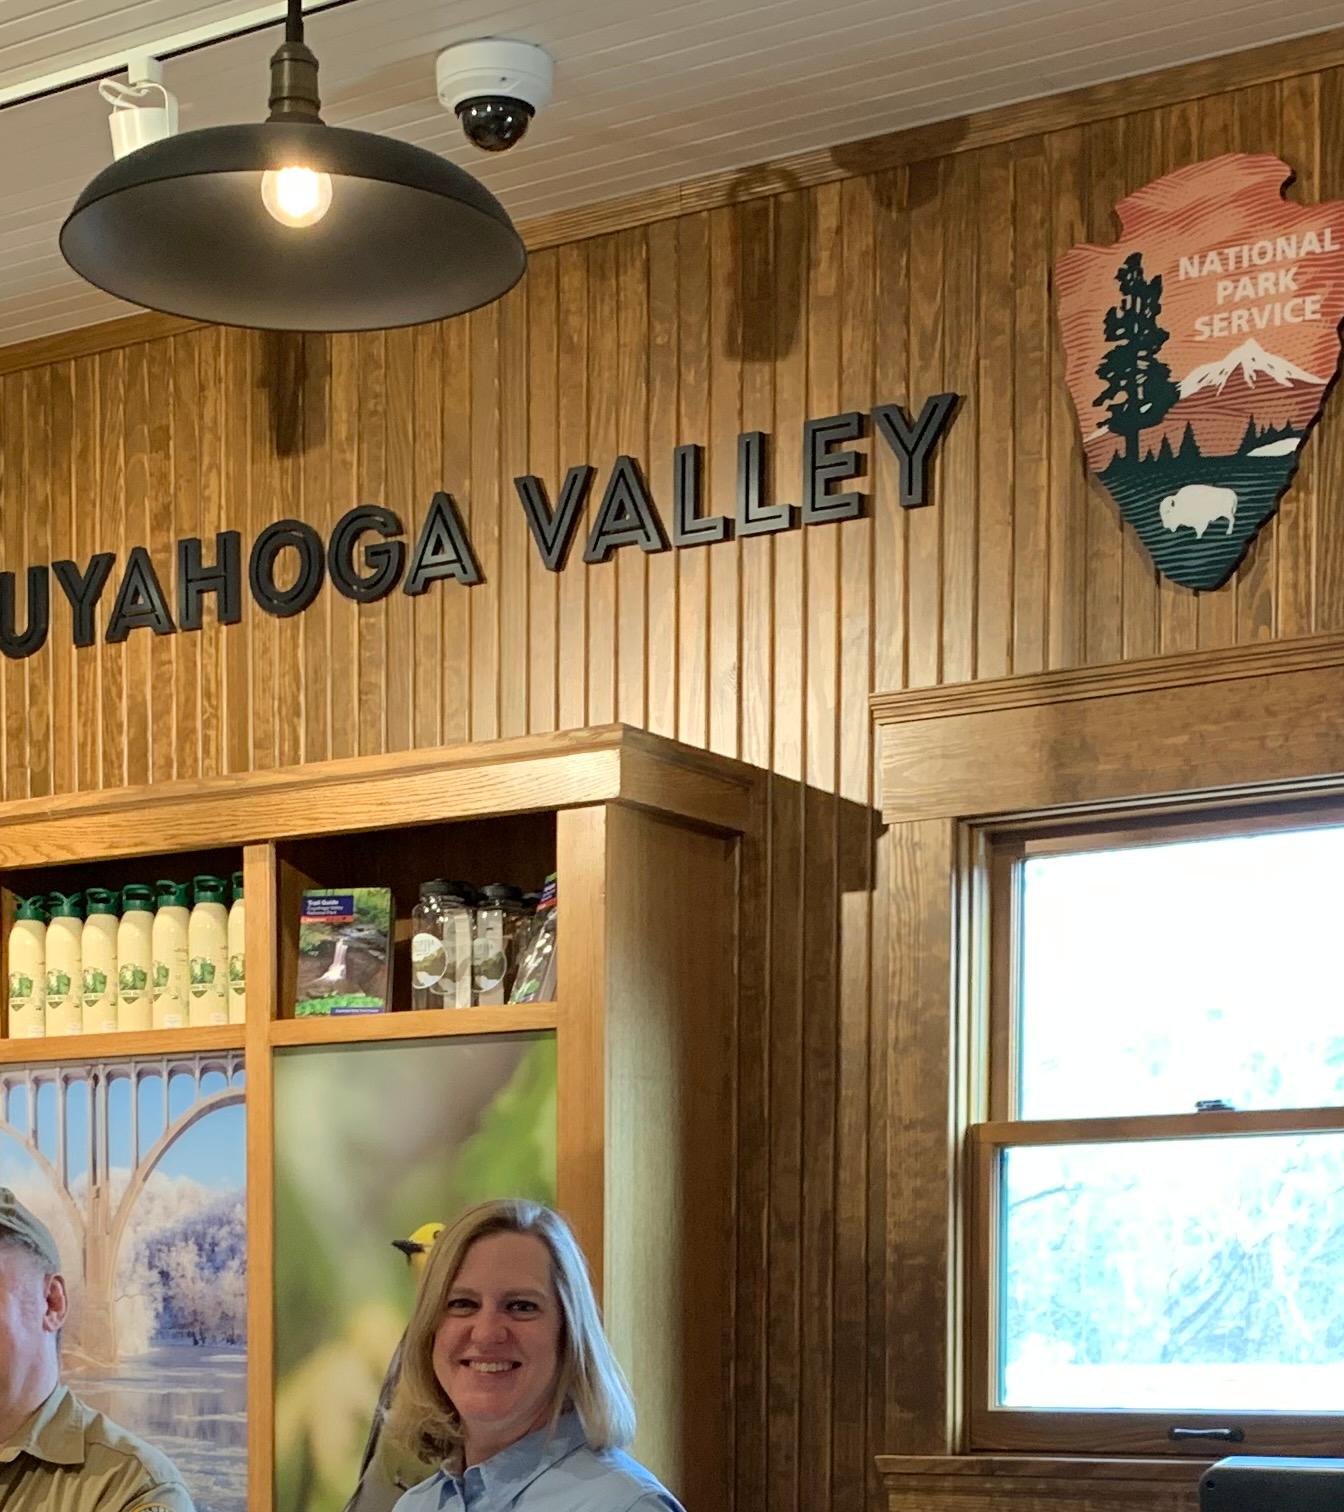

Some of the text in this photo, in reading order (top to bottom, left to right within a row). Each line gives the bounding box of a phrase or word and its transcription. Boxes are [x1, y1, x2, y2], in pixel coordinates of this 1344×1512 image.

[1178, 226, 1342, 281] NATIONAL
[1216, 266, 1299, 306] PARK
[1193, 294, 1323, 342] SERVICE
[513, 391, 968, 573] VALLEY
